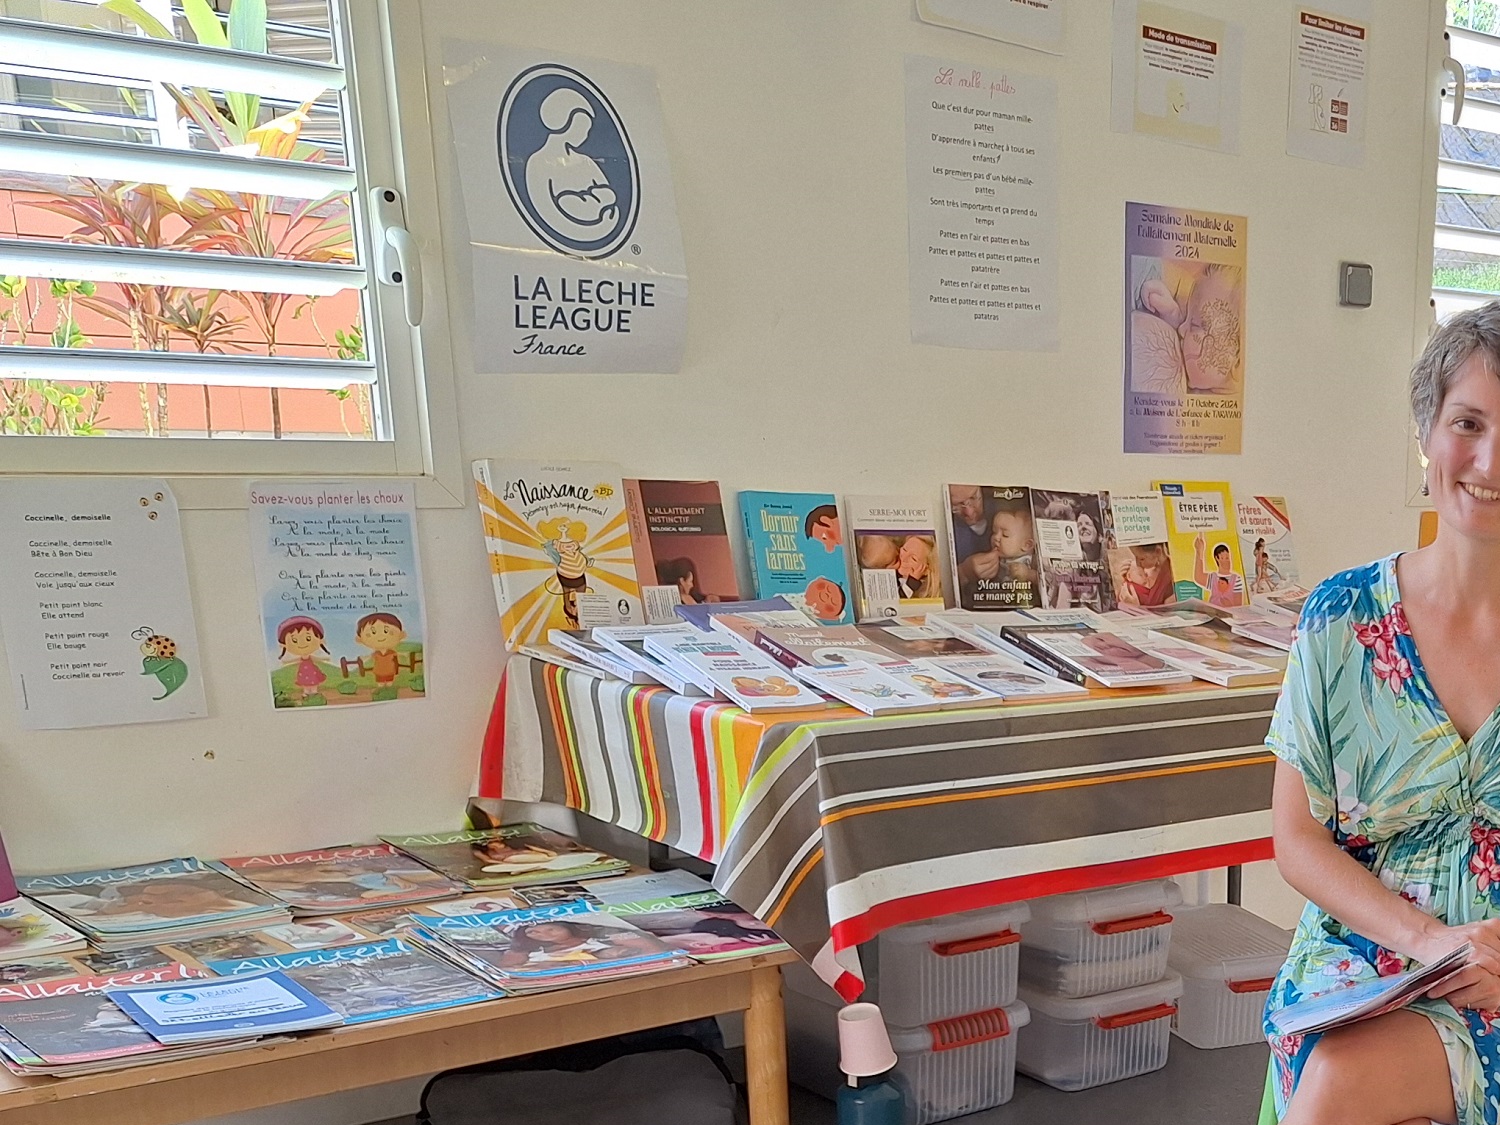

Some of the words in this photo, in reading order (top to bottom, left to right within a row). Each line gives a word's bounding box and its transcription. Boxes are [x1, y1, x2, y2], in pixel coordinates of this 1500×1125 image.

[1149, 28, 1165, 40] Mode
[1166, 34, 1174, 42] de
[1175, 36, 1212, 51] transmission
[935, 67, 954, 86] Le
[932, 101, 945, 110] Que
[947, 104, 962, 112] c'est
[963, 106, 974, 114] dur
[976, 109, 991, 117] pour
[993, 111, 1015, 121] maman
[1016, 115, 1033, 124] mille-
[974, 123, 994, 132] pattes
[931, 133, 971, 146] D'apprendre
[1011, 145, 1025, 154] tous
[933, 166, 943, 175] Les
[945, 169, 972, 178] premiers
[974, 172, 984, 180] pas
[1002, 175, 1016, 184] bébé
[975, 187, 995, 195] pattes
[930, 197, 945, 206] Sont
[946, 199, 959, 208] très
[960, 201, 993, 212] importants
[975, 217, 994, 226] temps
[1141, 209, 1181, 225] Semaine
[1184, 214, 1221, 231] Mondiale
[1224, 220, 1234, 232] de
[940, 230, 959, 239] Pattes
[969, 232, 981, 241] l'air
[991, 236, 1009, 244] pattes
[1194, 231, 1237, 247] Maternelle
[929, 246, 948, 255] Pattes
[957, 250, 977, 258] pattes
[986, 253, 1005, 261] pattes
[1175, 244, 1199, 259] 2024
[514, 275, 552, 301] LA
[561, 277, 655, 307] LECHE
[515, 304, 632, 333] LEAGUE
[974, 312, 999, 321] patatras
[513, 334, 587, 355] France
[1220, 399, 1238, 409] 2024
[251, 491, 313, 505] Savez-vous
[317, 490, 353, 507] planter
[357, 490, 371, 504] les
[374, 490, 404, 504] choux
[503, 481, 514, 500] La
[512, 479, 593, 506] Naissance
[599, 487, 614, 496] BD
[648, 507, 705, 515] L'ALLAITEMENT
[909, 509, 926, 517] FORT
[1113, 504, 1148, 514] Technique
[1179, 502, 1197, 512] ÊTRE
[1199, 502, 1218, 513] PÈRE
[1237, 503, 1261, 515] Frères
[760, 509, 799, 533] Dormir
[1122, 515, 1150, 524] pratique
[1240, 515, 1247, 524] et
[1249, 517, 1272, 525] sœurs
[1124, 524, 1150, 534] portage
[770, 533, 797, 551] sans
[765, 547, 806, 571] larmes
[978, 579, 1000, 590] Mon
[1001, 579, 1031, 592] enfant
[974, 593, 984, 601] ne
[986, 593, 1015, 603] mange
[1016, 592, 1033, 603] pas
[62, 602, 81, 610] point
[58, 611, 85, 619] attend
[67, 632, 85, 640] point
[52, 672, 90, 680] Coccinelle
[241, 848, 390, 868] Allaiter
[27, 864, 177, 888] Allaiter
[437, 904, 579, 928] Allaiter
[233, 944, 391, 974] Allaiter
[0, 967, 172, 1000] Allaiter
